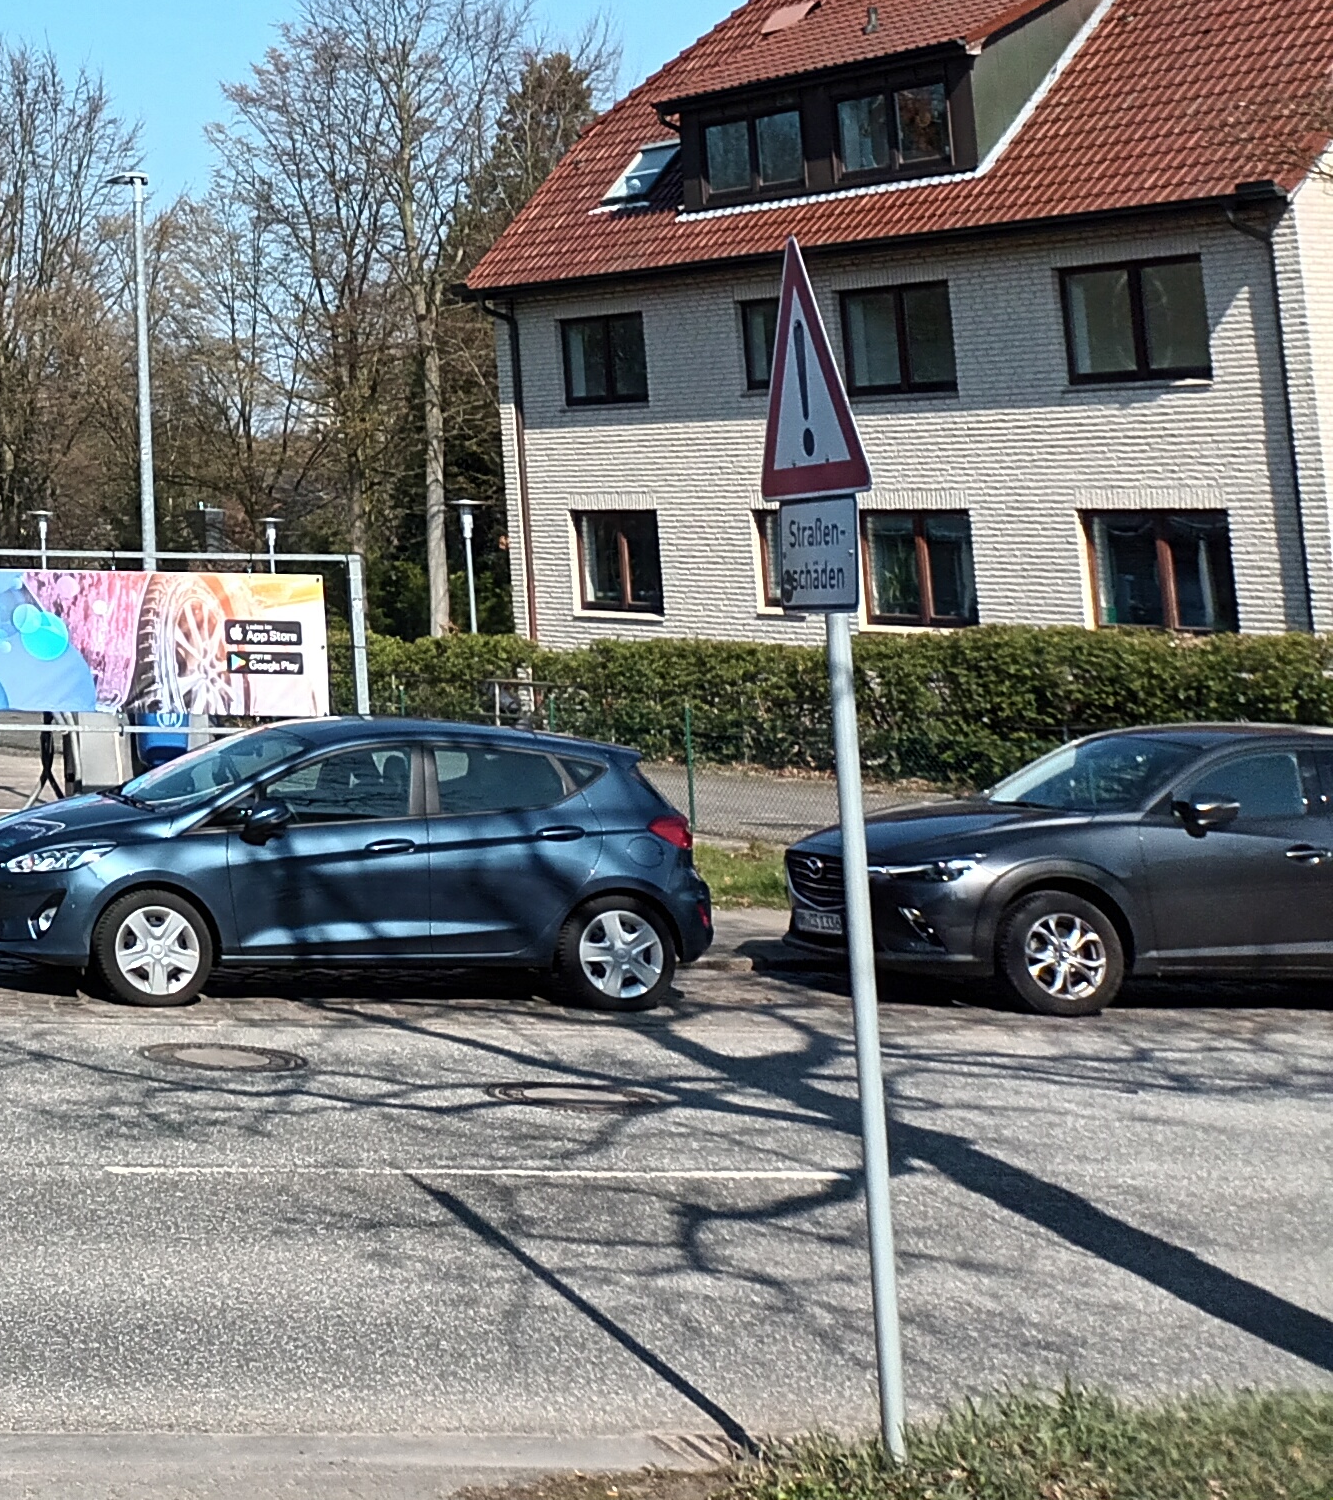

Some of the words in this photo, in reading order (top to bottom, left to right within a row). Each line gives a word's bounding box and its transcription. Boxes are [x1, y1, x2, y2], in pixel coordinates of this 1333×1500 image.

[789, 517, 846, 548] Straßen-
[792, 561, 845, 591] schäden
[246, 630, 268, 643] App
[269, 630, 297, 642] Store
[249, 660, 280, 672] Google
[280, 660, 299, 673] Play
